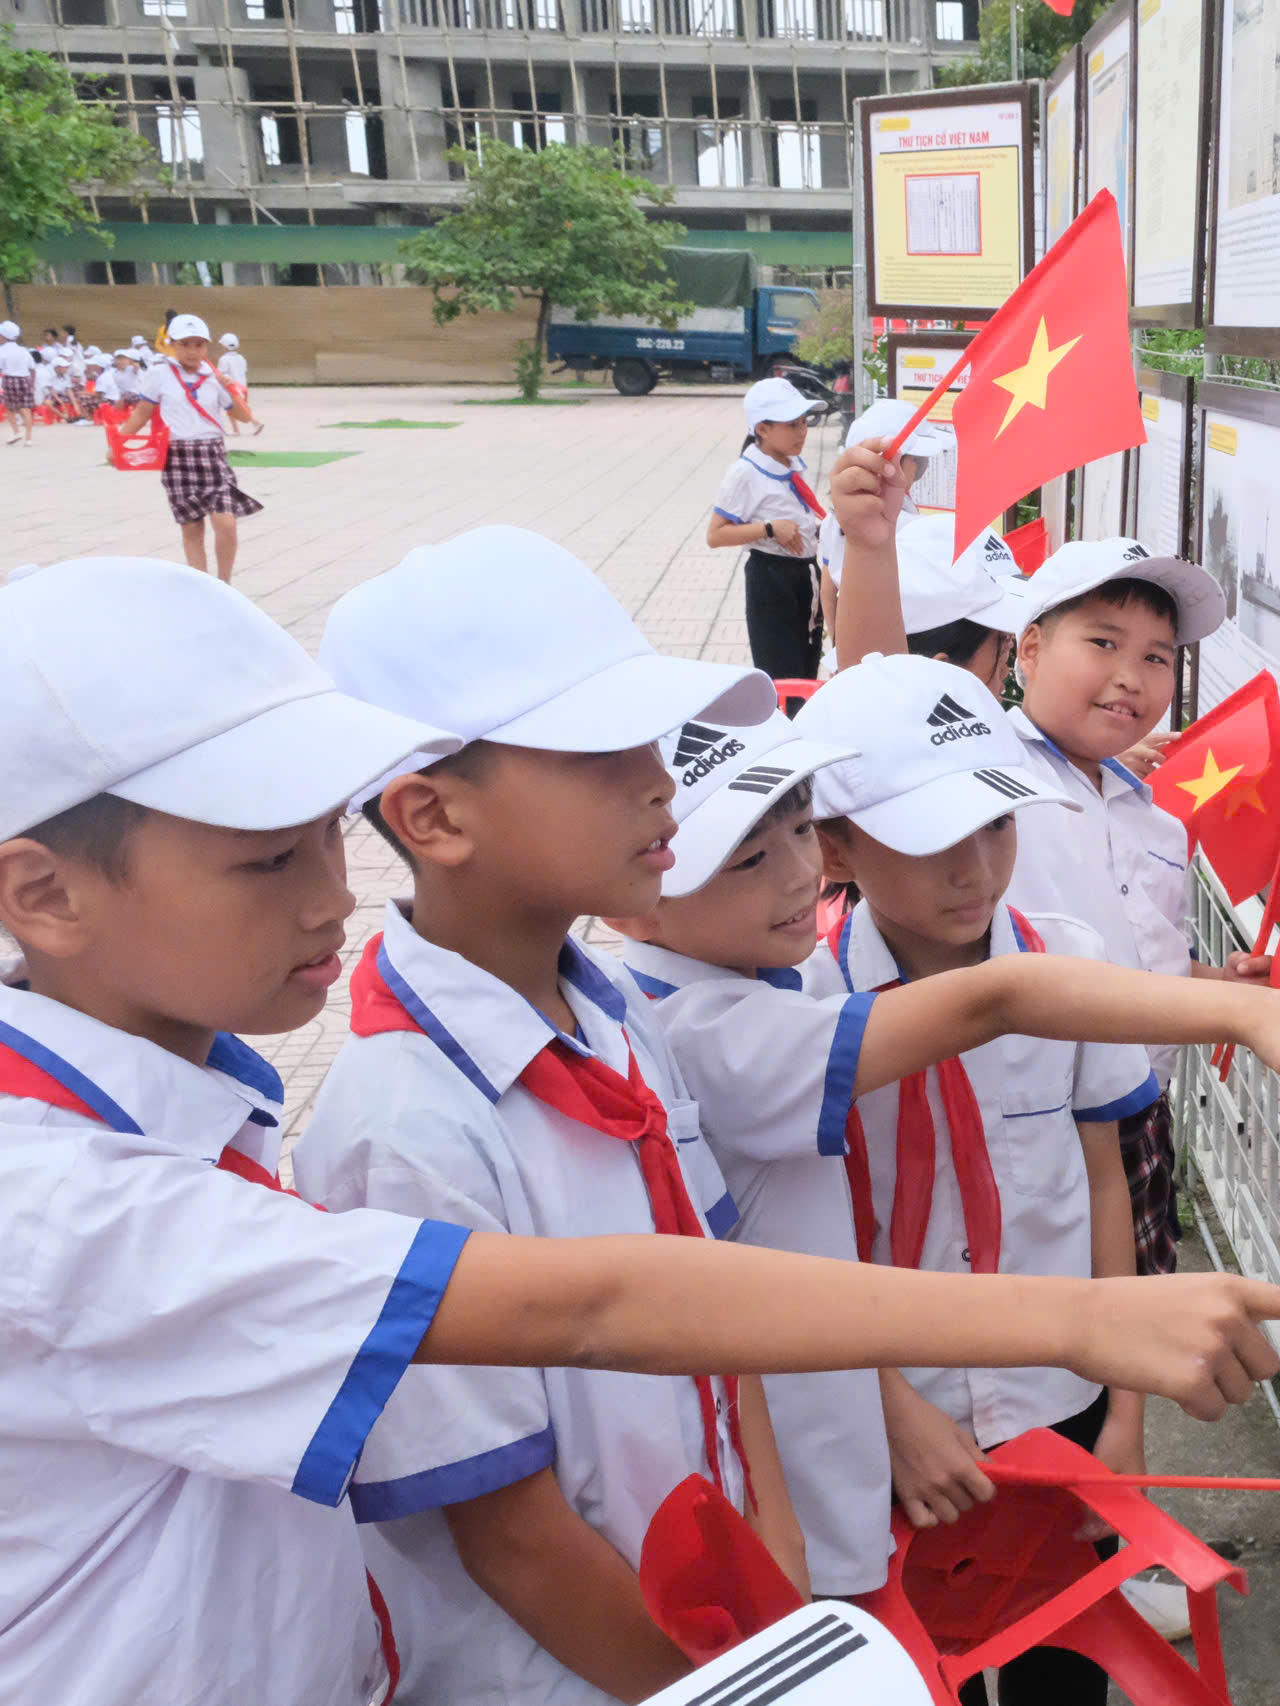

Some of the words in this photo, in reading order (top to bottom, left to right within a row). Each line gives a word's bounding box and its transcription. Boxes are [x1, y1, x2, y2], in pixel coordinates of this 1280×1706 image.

[969, 131, 990, 144] NAM
[985, 551, 1011, 562] adida
[930, 720, 991, 746] adidas
[681, 737, 745, 787] adidas
